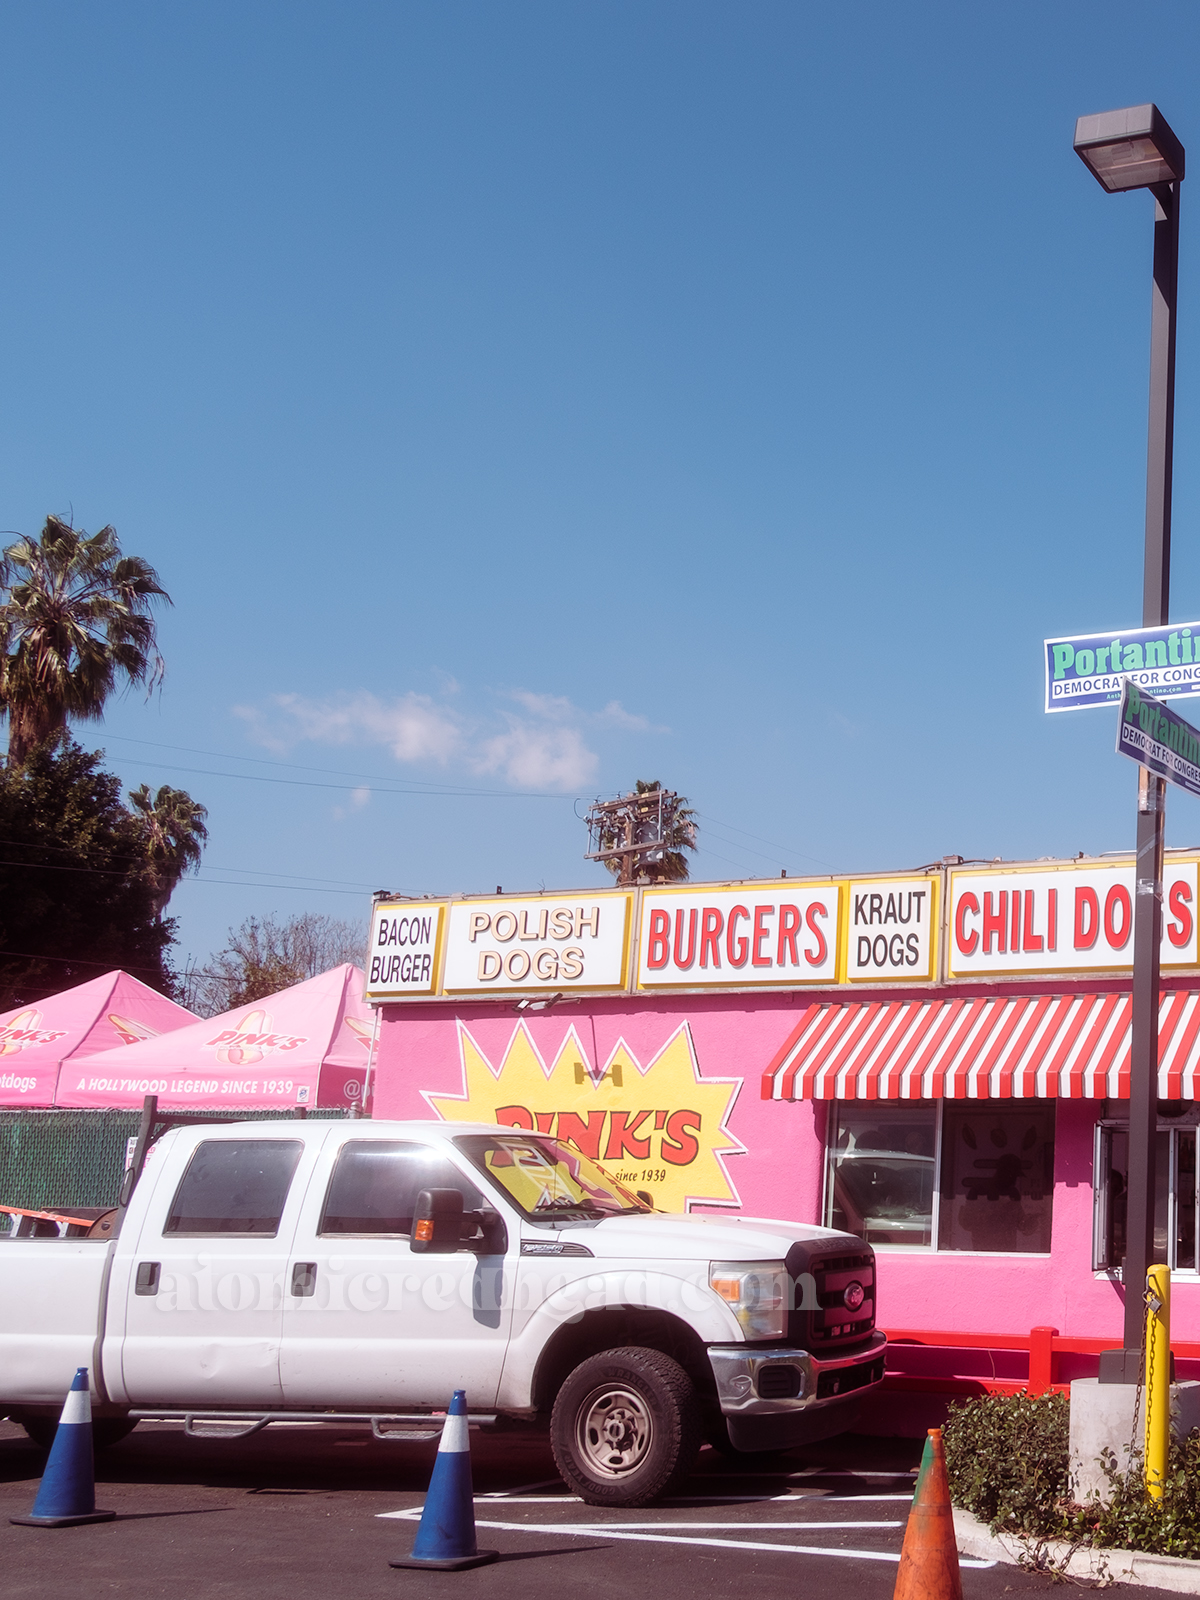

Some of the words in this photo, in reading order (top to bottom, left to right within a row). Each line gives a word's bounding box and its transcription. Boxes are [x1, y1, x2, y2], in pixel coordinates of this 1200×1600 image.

[1054, 675, 1123, 696] DEMOCRA
[1131, 672, 1159, 685] FOR
[1123, 726, 1160, 758] DEMOCRAT
[1162, 749, 1174, 766] FOR
[854, 891, 926, 925] KRAUT
[955, 887, 1058, 956] CHILI
[1073, 880, 1193, 950] DOS
[378, 916, 432, 946] BACON
[469, 907, 600, 942] POLISH
[647, 901, 828, 970] BURGERS
[477, 947, 585, 981] DOGS
[857, 933, 919, 968] DOGS
[370, 954, 431, 984] BURGER
[205, 1030, 309, 1050] PINK'S
[0, 1072, 37, 1093] tdogs
[76, 1078, 86, 1091] A
[88, 1078, 168, 1093] HOLLYWOOD
[170, 1080, 219, 1094] LEGEND
[221, 1080, 260, 1094] SINCE
[262, 1080, 294, 1094] 1939
[615, 1171, 637, 1183] since
[641, 1169, 667, 1183] 1939
